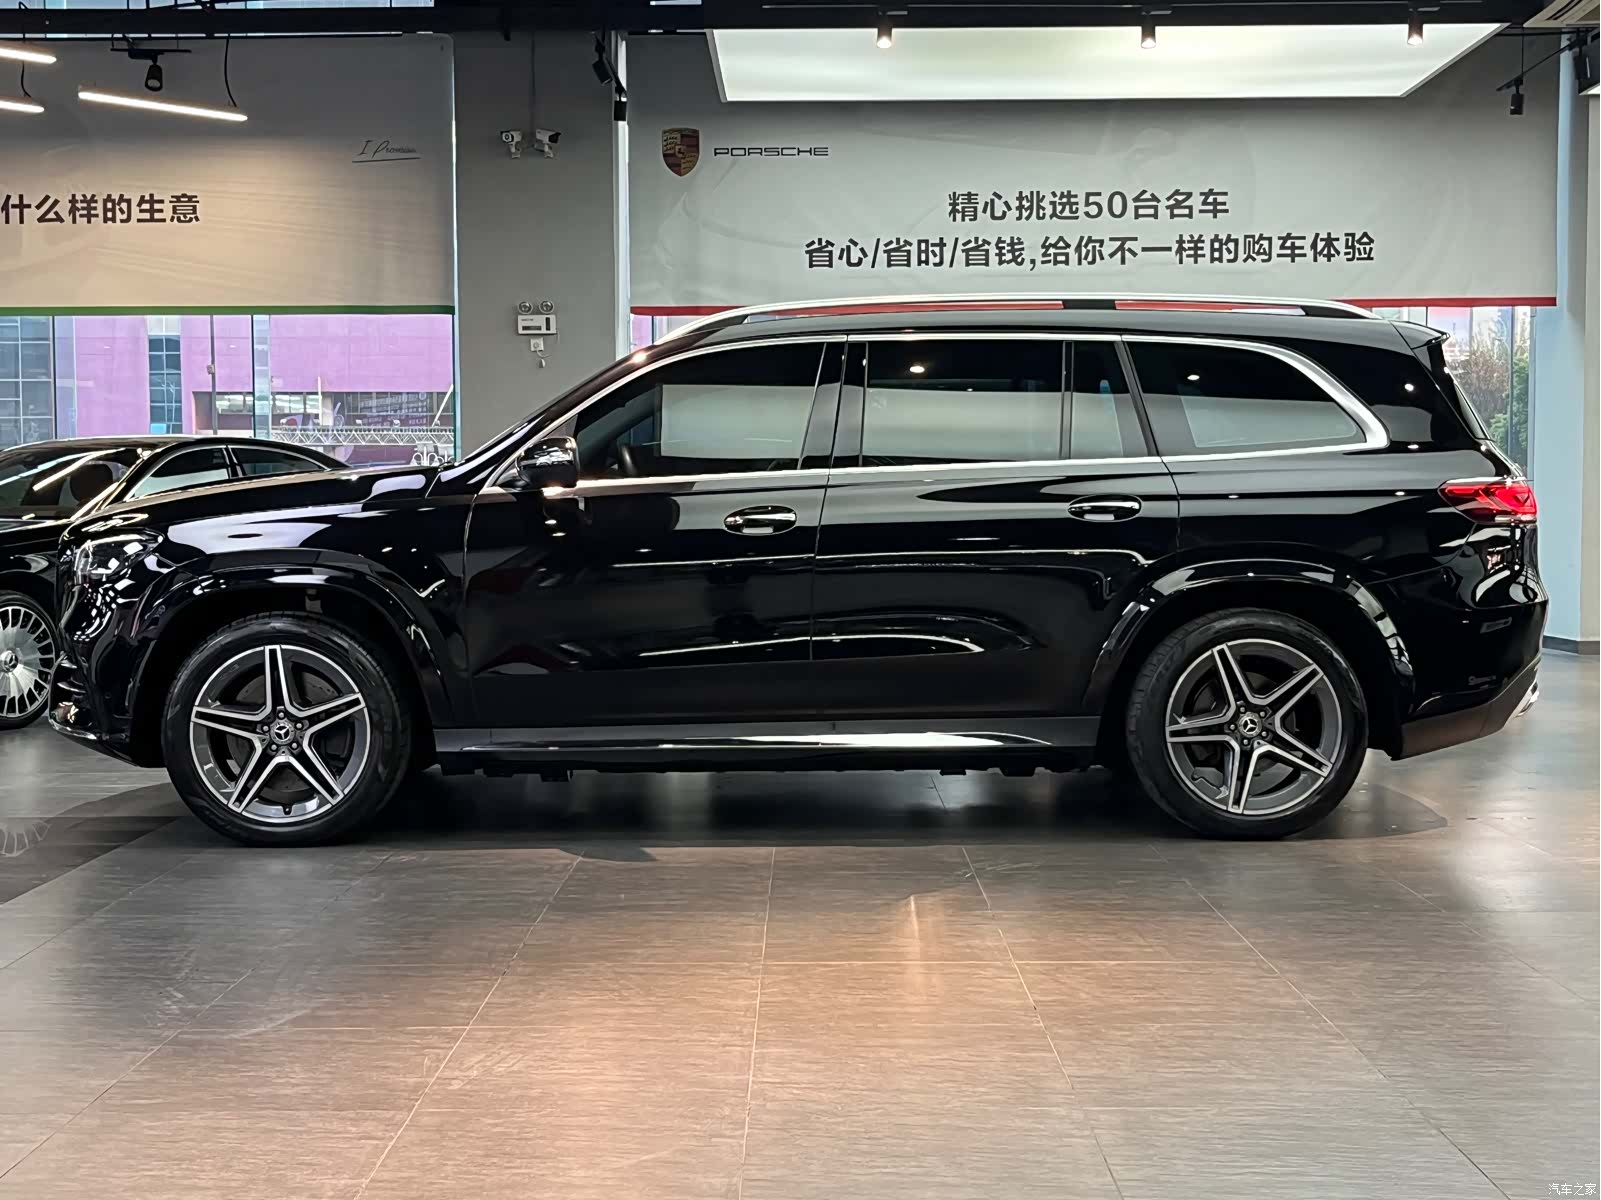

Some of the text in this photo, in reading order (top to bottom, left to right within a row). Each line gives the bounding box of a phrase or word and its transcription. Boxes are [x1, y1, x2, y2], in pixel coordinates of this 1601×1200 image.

[713, 146, 829, 157] PORSCHE
[0, 193, 200, 225] 什么样的生意
[948, 188, 1230, 222] 精心挑选50台名车
